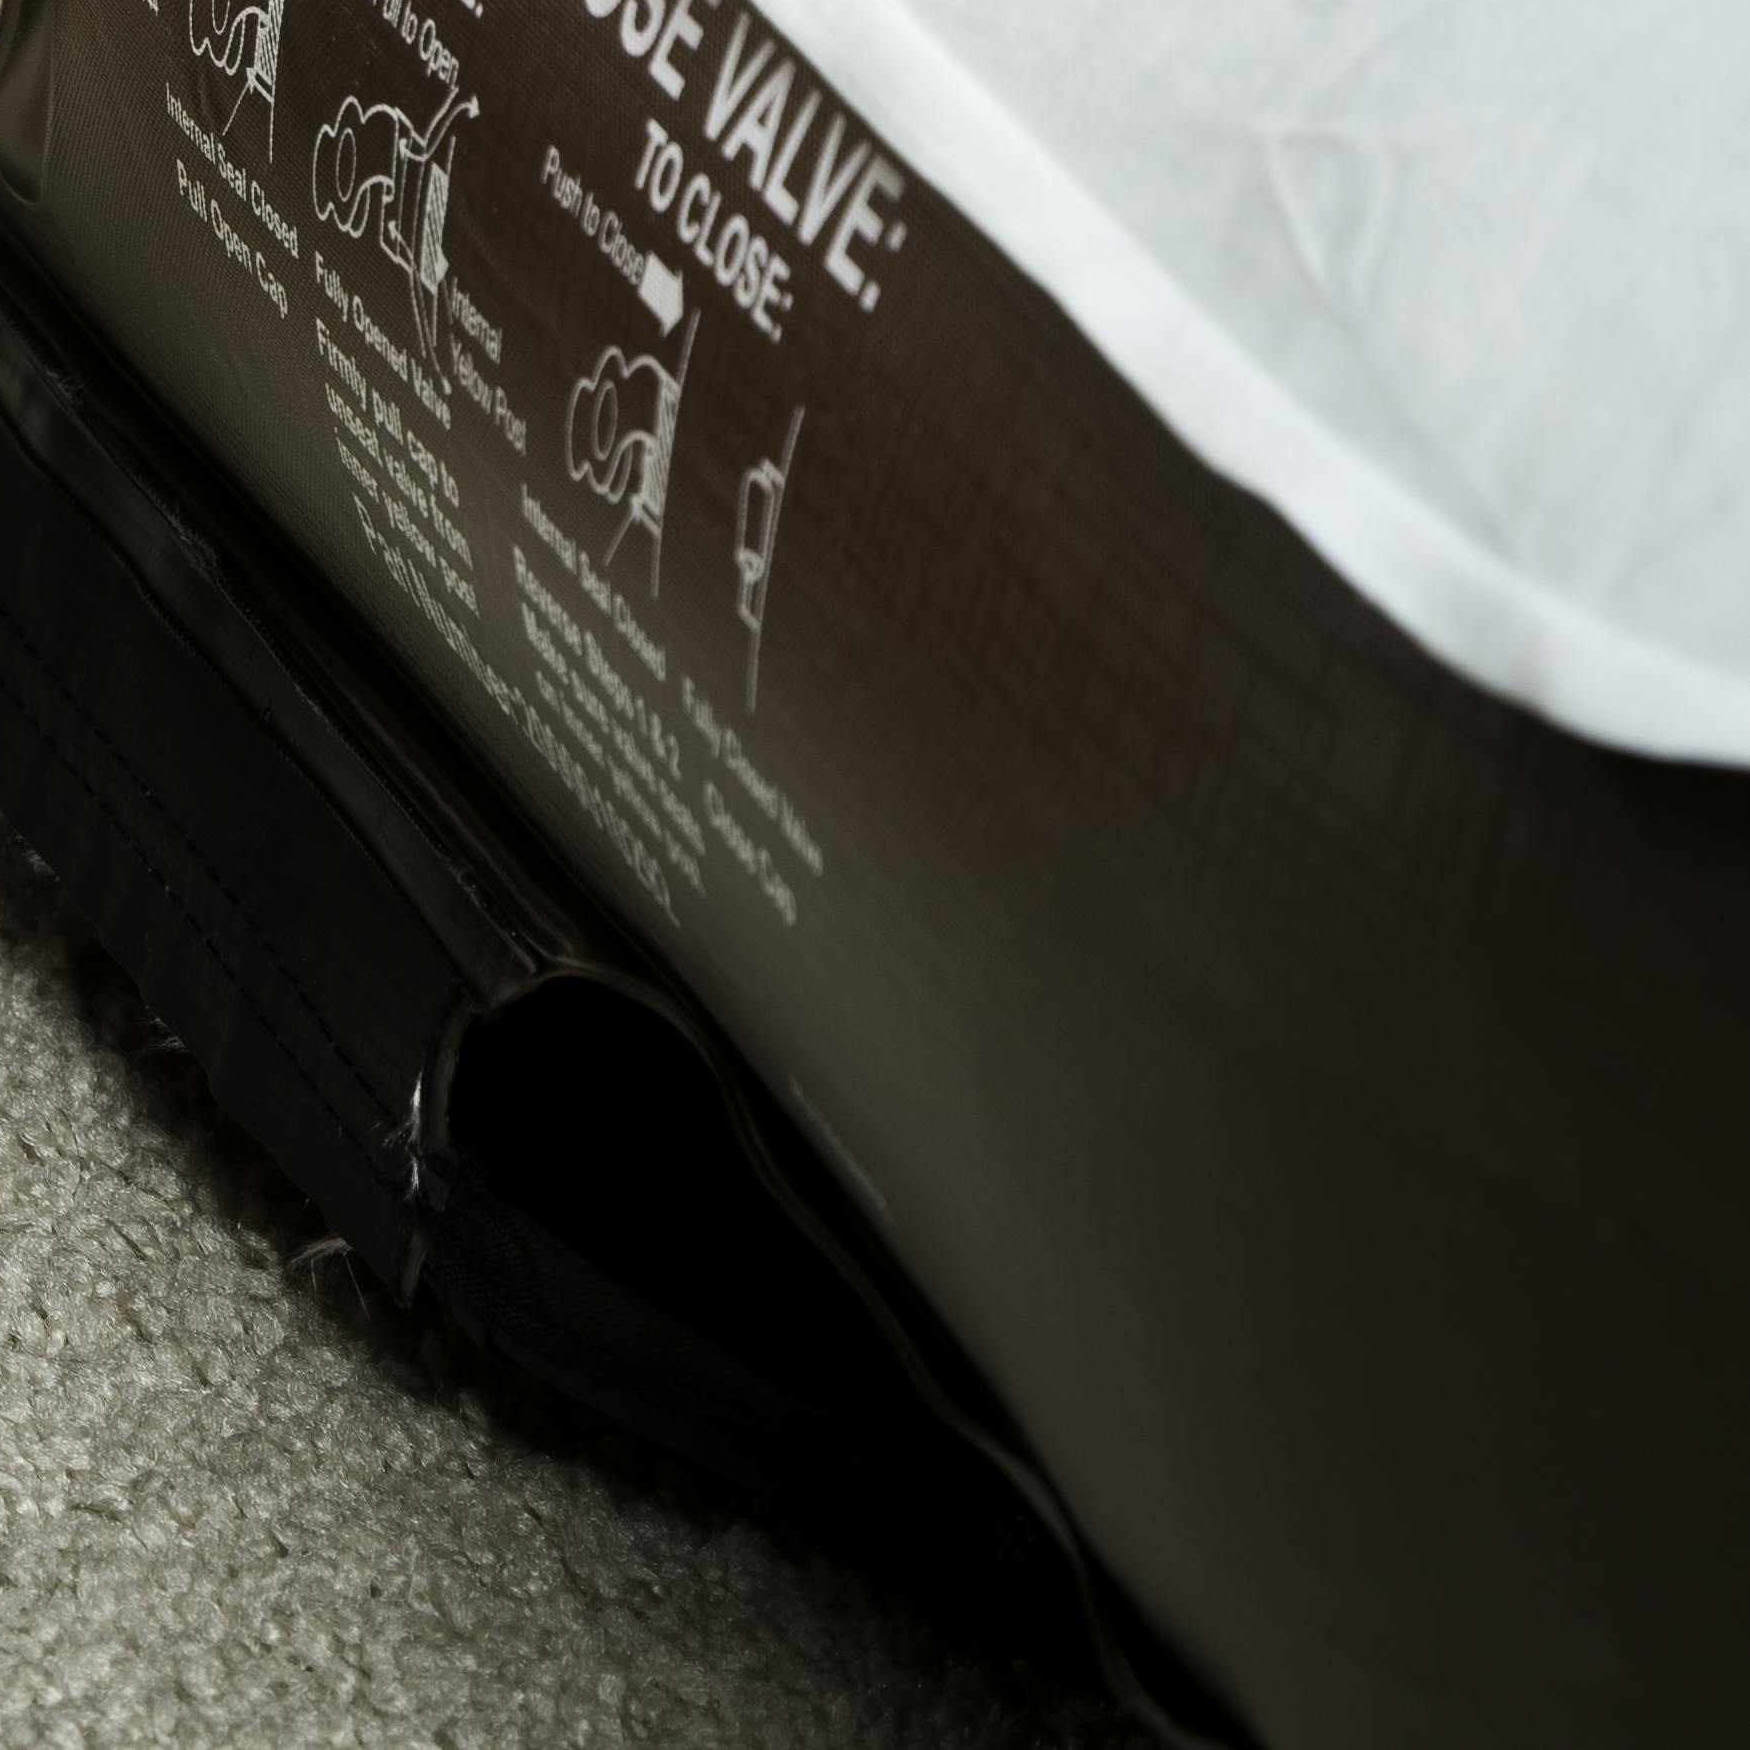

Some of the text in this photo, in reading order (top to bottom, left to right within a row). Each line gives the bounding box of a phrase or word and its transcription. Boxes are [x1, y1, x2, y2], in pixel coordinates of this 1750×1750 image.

[400, 0, 419, 45] to
[418, 17, 461, 86] Open
[165, 81, 300, 260] Internal Seal Closed
[175, 157, 289, 321] Pull Open Cap
[540, 143, 647, 287] Push to Close
[633, 116, 794, 344] TO CLOSE:
[704, 12, 908, 313] VALVE:
[314, 250, 452, 432] Fully Opened Valve
[450, 332, 528, 457] Yellow Post
[451, 275, 503, 366] Internal
[315, 317, 460, 509] Firmly pull cap to
[324, 382, 475, 571] unseat valve from
[382, 489, 438, 570] yellow
[520, 482, 667, 684] Internal Seal Closed
[512, 542, 583, 656] Reverse
[583, 630, 635, 721] Steps
